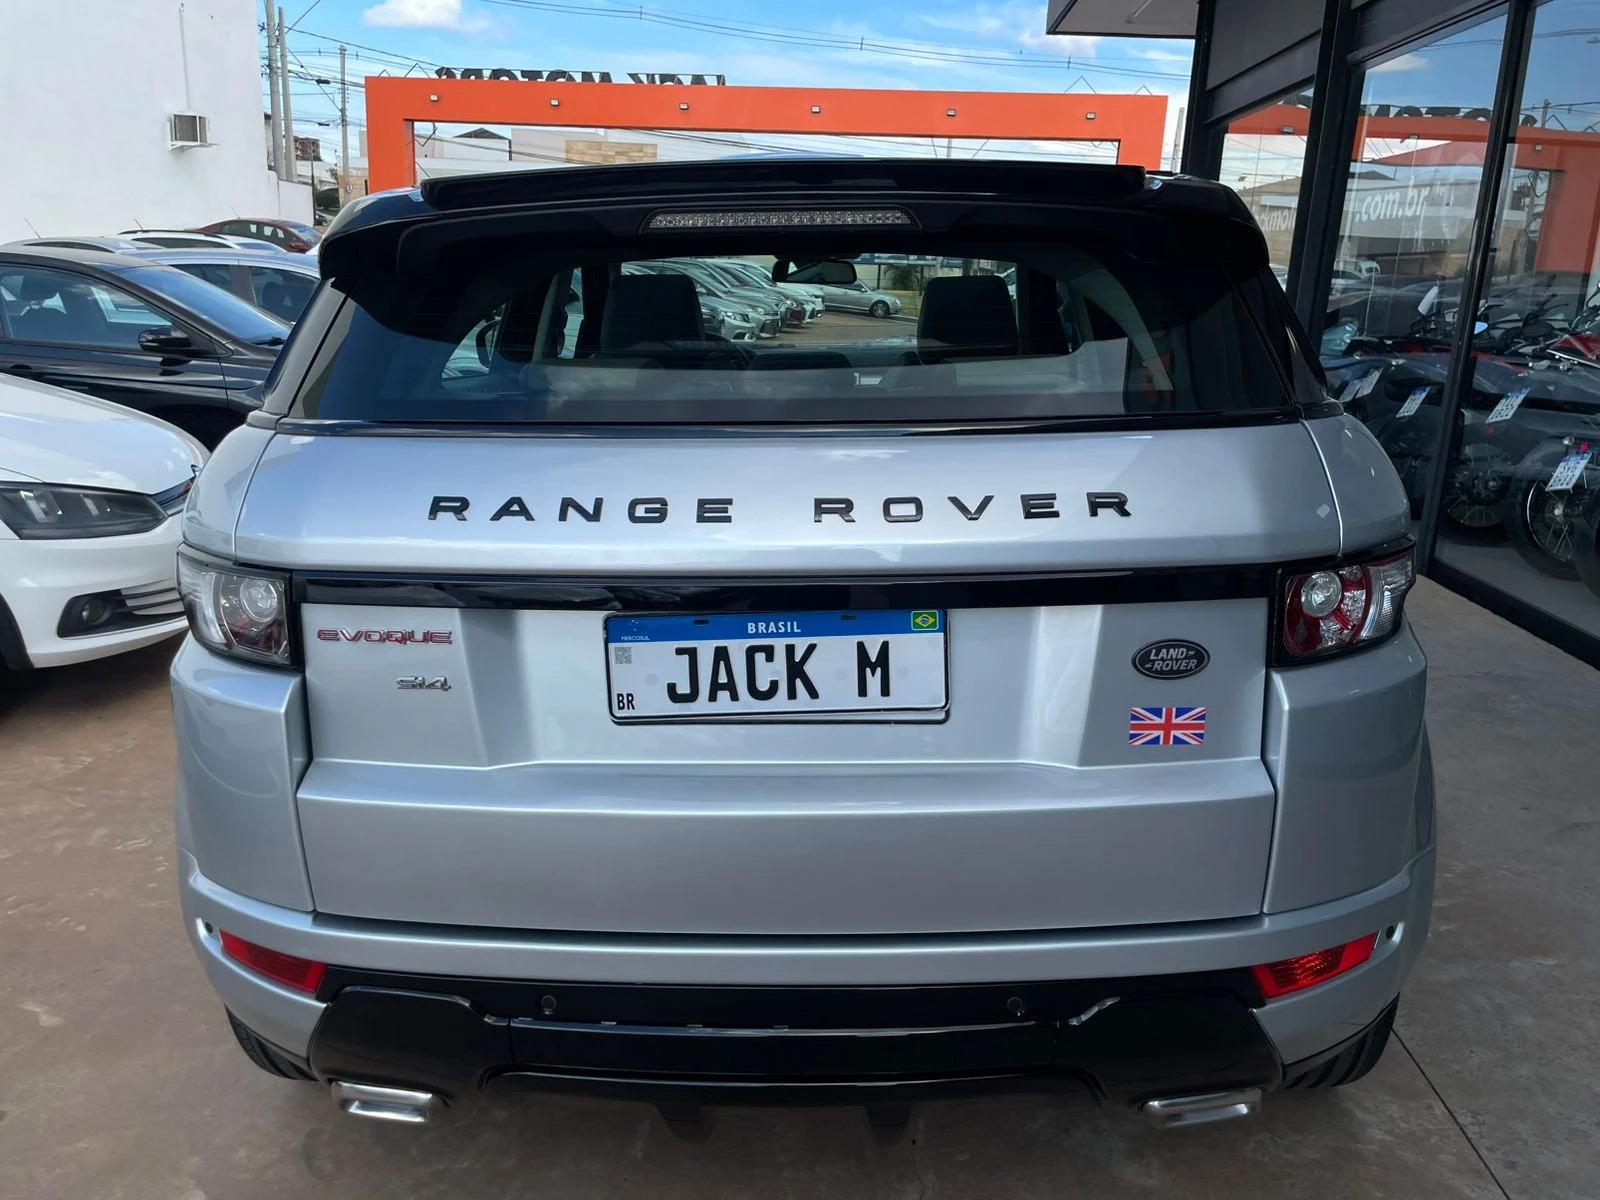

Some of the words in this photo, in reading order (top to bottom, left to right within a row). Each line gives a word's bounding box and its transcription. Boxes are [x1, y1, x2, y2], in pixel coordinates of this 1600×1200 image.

[428, 495, 733, 524] RANGE
[812, 491, 1134, 524] ROVER
[316, 627, 453, 646] EVOQUE
[747, 621, 802, 635] BRASIL
[666, 642, 820, 704] JACK
[856, 640, 891, 698] M
[616, 693, 635, 711] BR
